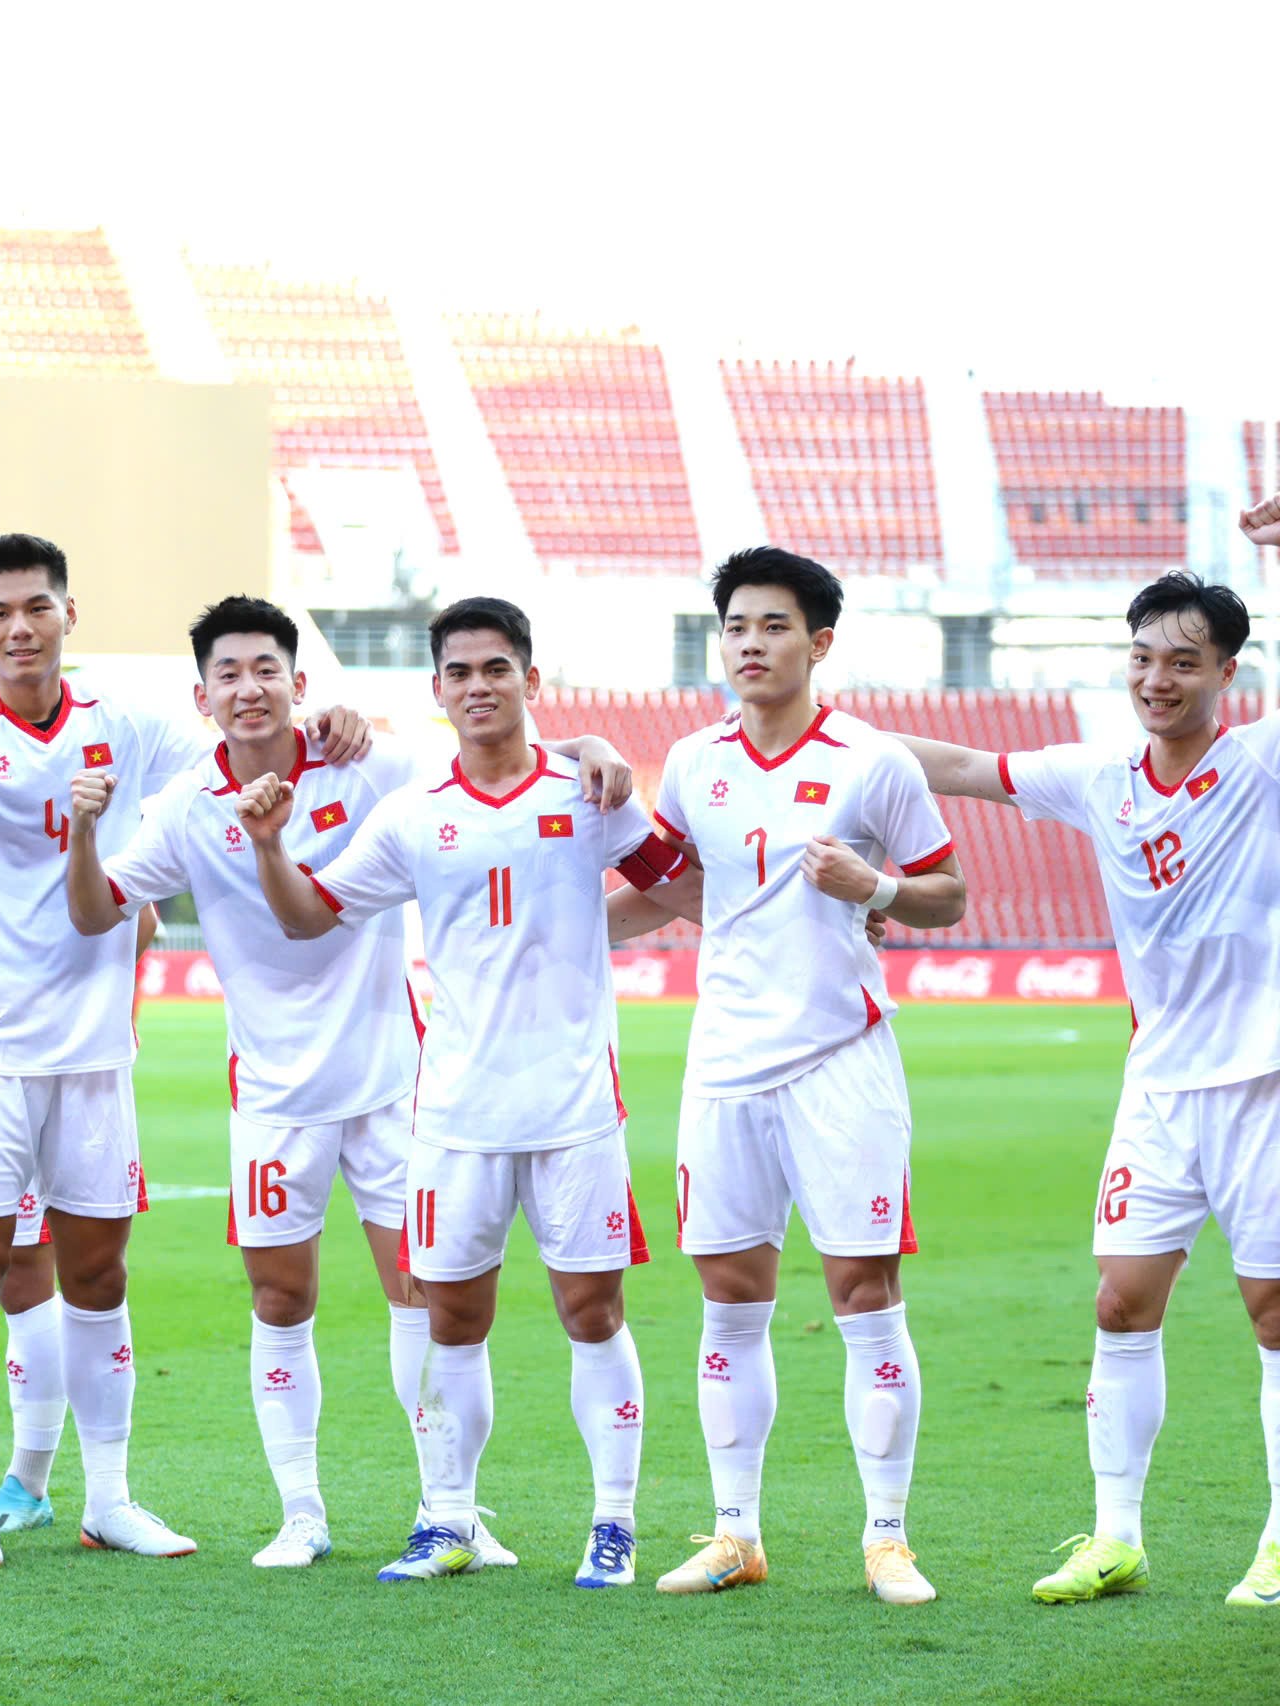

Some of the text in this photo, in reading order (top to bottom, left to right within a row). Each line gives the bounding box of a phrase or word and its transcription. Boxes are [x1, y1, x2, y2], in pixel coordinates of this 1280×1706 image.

[45, 799, 69, 853] 4
[745, 827, 767, 887] 7
[1140, 830, 1186, 891] 12
[489, 867, 512, 927] 11
[249, 1159, 287, 1219] 16
[416, 1188, 435, 1249] 11
[1097, 1166, 1132, 1226] 12
